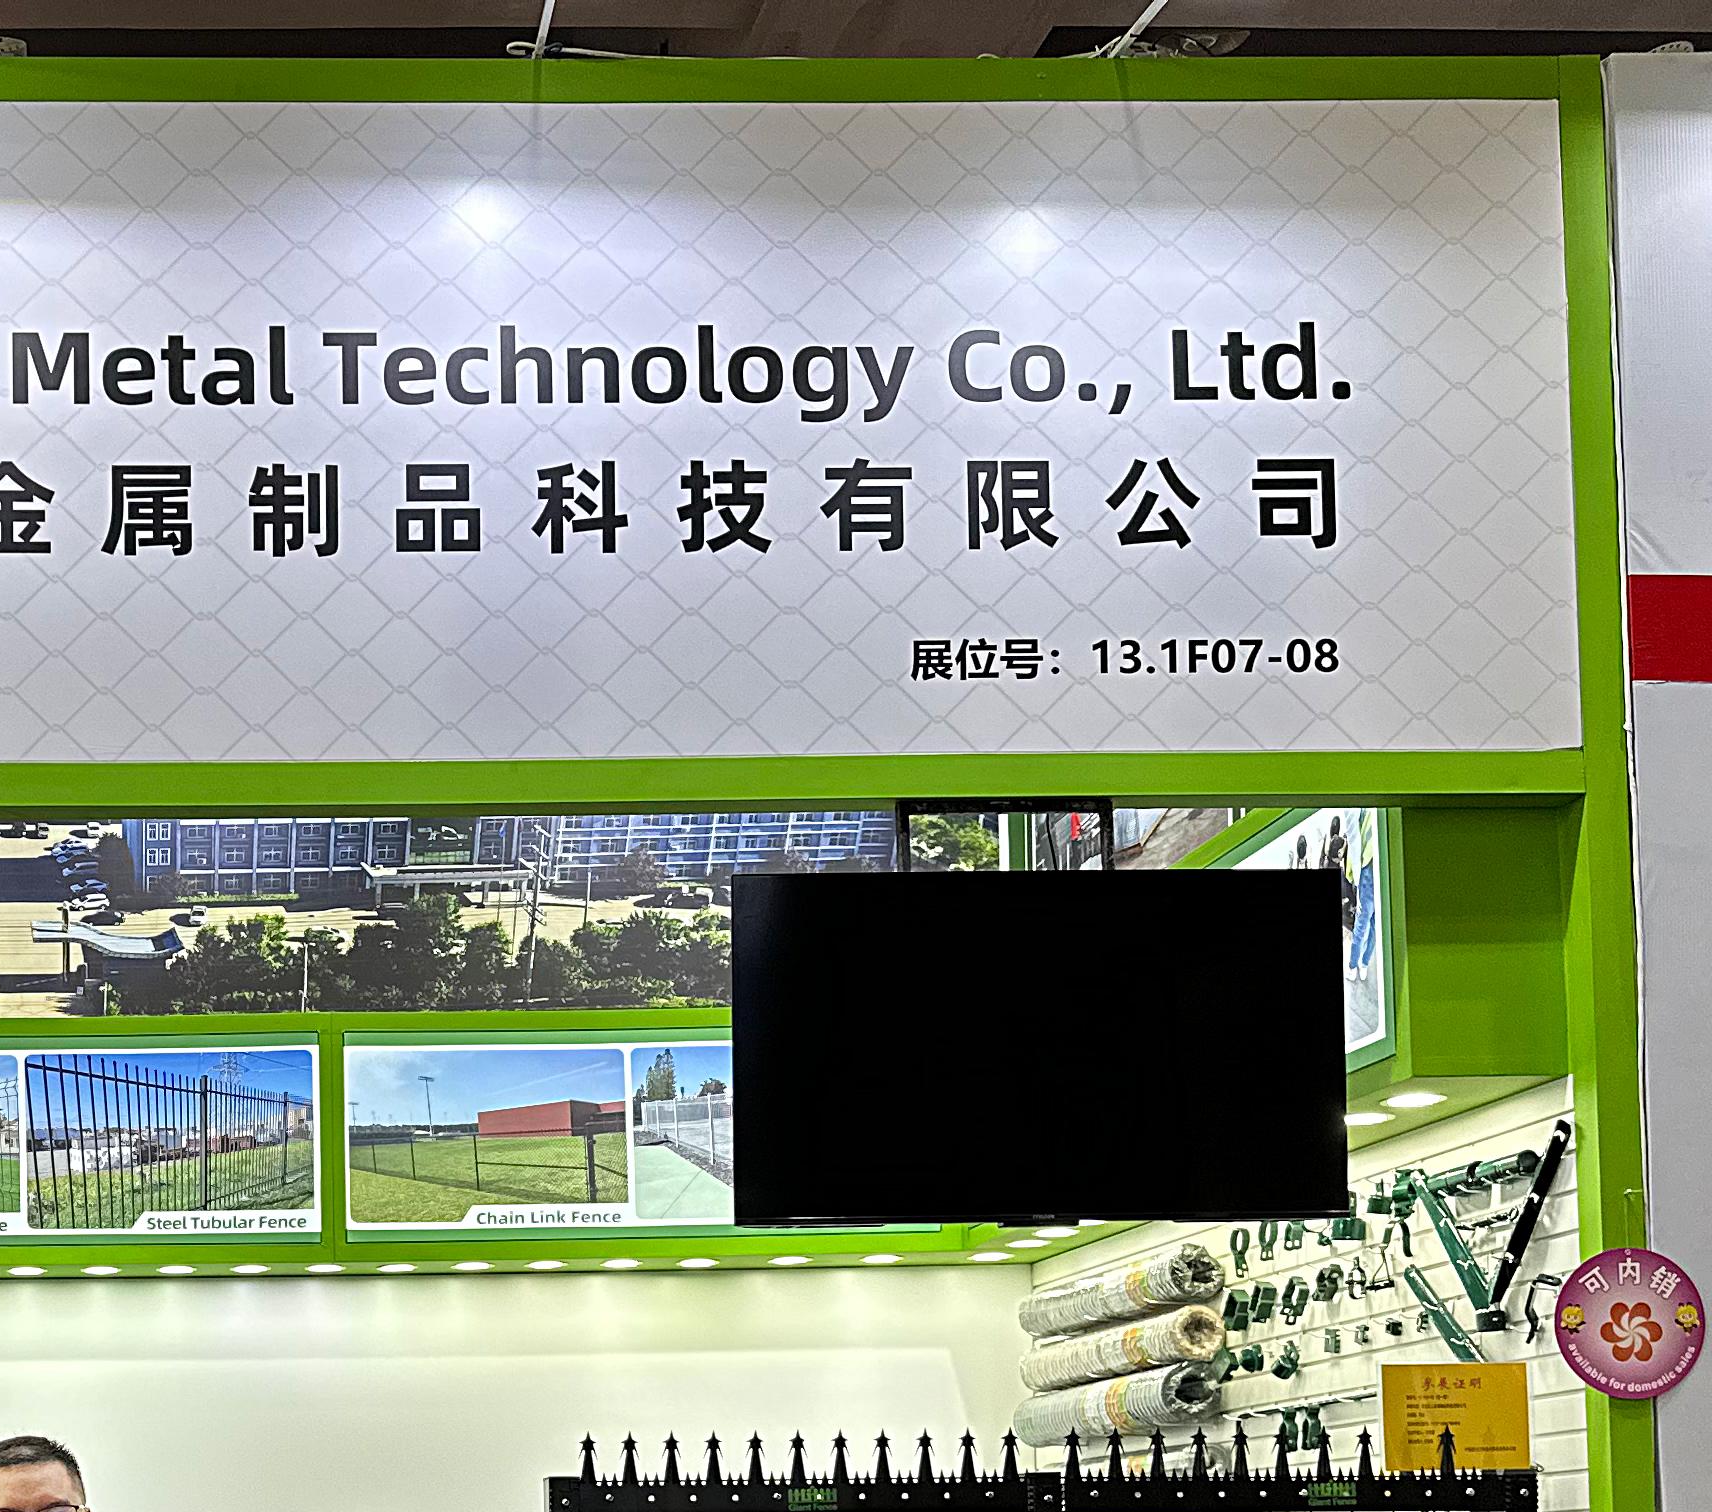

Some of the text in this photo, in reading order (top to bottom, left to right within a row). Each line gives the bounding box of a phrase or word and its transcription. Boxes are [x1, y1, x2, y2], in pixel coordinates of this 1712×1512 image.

[12, 325, 296, 407] Metal
[322, 325, 916, 424] Technology
[947, 330, 1134, 416] Co.,
[1171, 321, 1353, 402] Ltd.
[1092, 638, 1341, 676] 13.1F07-08
[146, 1215, 307, 1230] Steel Tubular Fence
[476, 1210, 622, 1225] Chain Link Fence
[1578, 1257, 1682, 1300] 可内销
[1567, 1342, 1696, 1393] available for domestic sales
